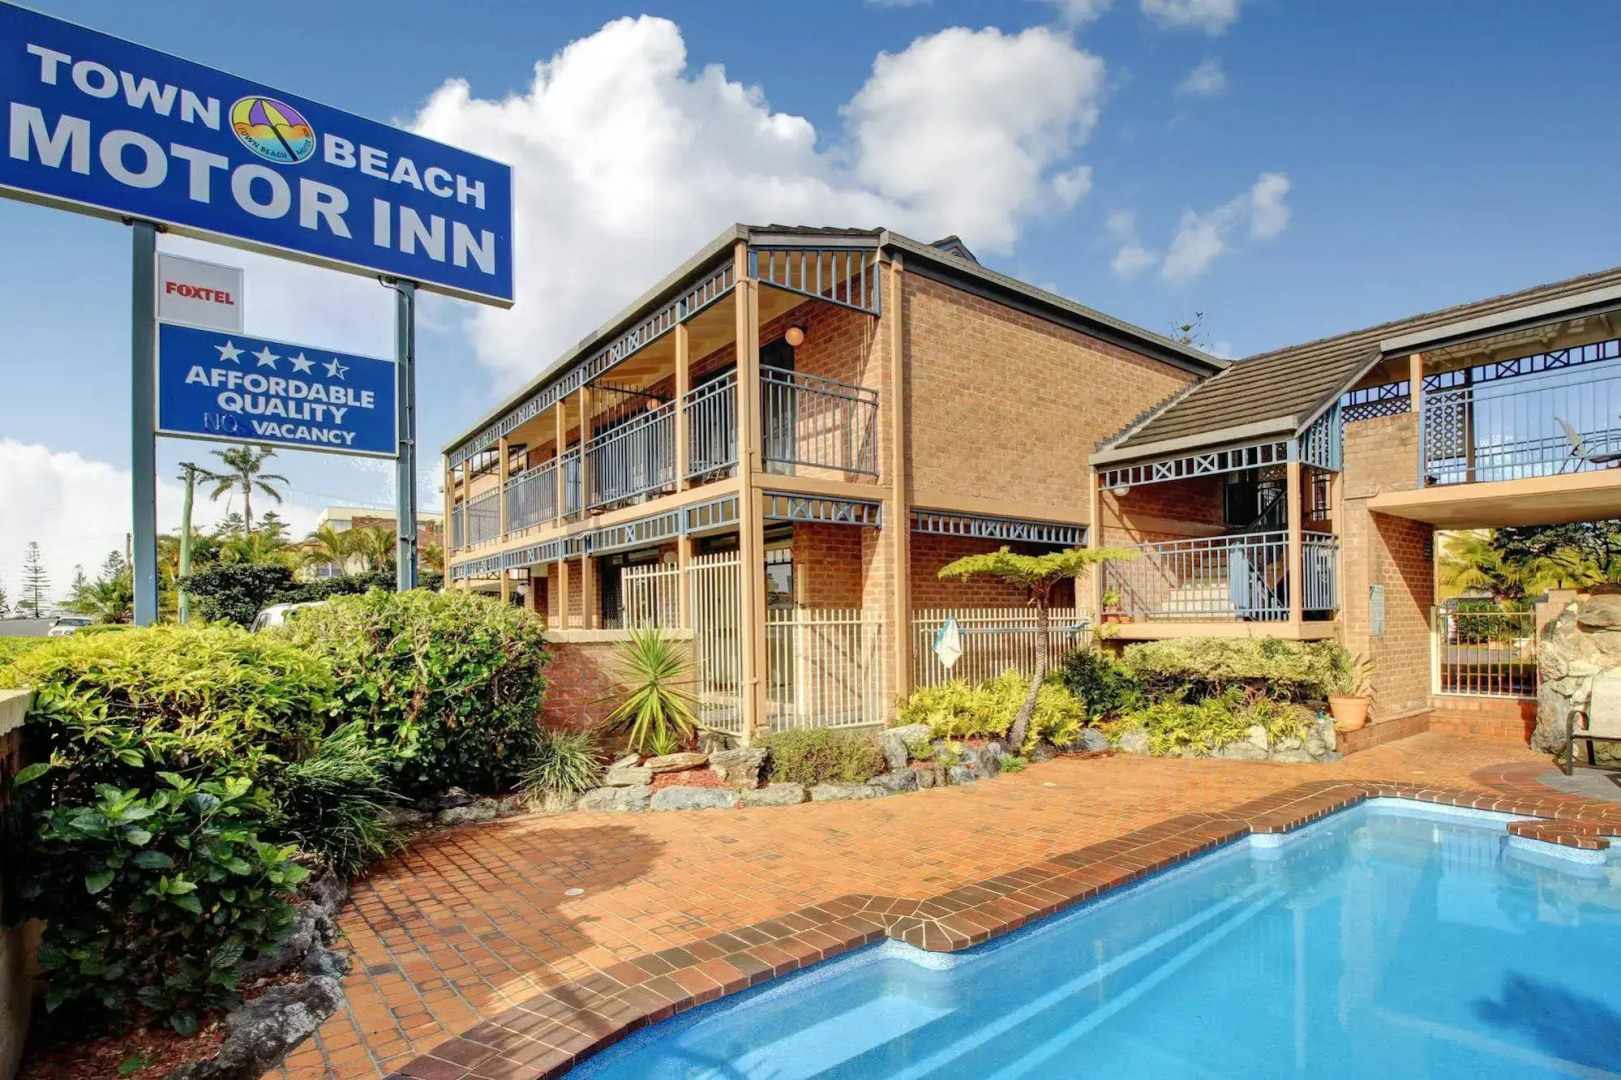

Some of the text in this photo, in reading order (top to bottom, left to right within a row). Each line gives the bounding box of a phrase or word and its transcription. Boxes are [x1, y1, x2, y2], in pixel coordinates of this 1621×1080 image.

[27, 44, 485, 209] TOWN BEACH
[238, 127, 260, 149] TOWN
[260, 145, 288, 159] BEACH
[10, 102, 495, 275] MOTOR INN
[166, 281, 234, 305] FOXTEL
[185, 365, 375, 409] AFFORDABLE
[217, 391, 348, 425] QUALITY
[204, 412, 356, 445] NO VACANCY
